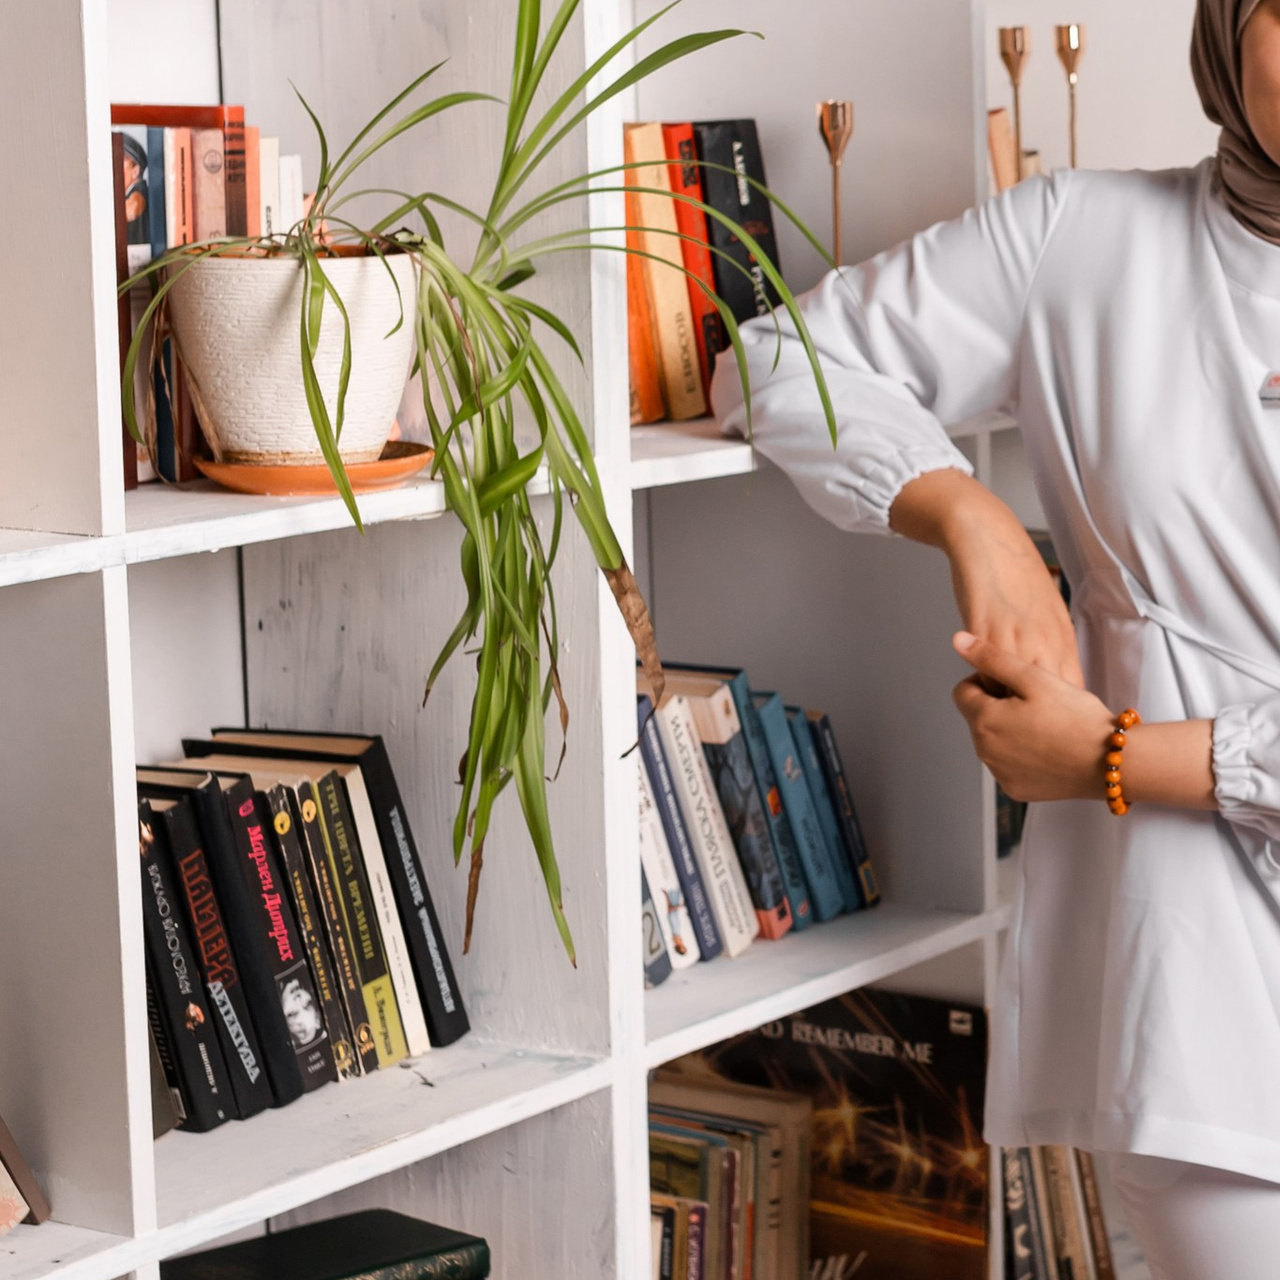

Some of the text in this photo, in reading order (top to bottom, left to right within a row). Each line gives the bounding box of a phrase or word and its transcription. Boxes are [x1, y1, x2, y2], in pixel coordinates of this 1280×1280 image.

[670, 715, 699, 799] СМЕРТИ
[695, 804, 726, 880] ПЛЯСКА
[246, 824, 294, 962] Марлен Дитрих
[791, 1021, 897, 1058] REMEMBER
[903, 1039, 934, 1065] ME
